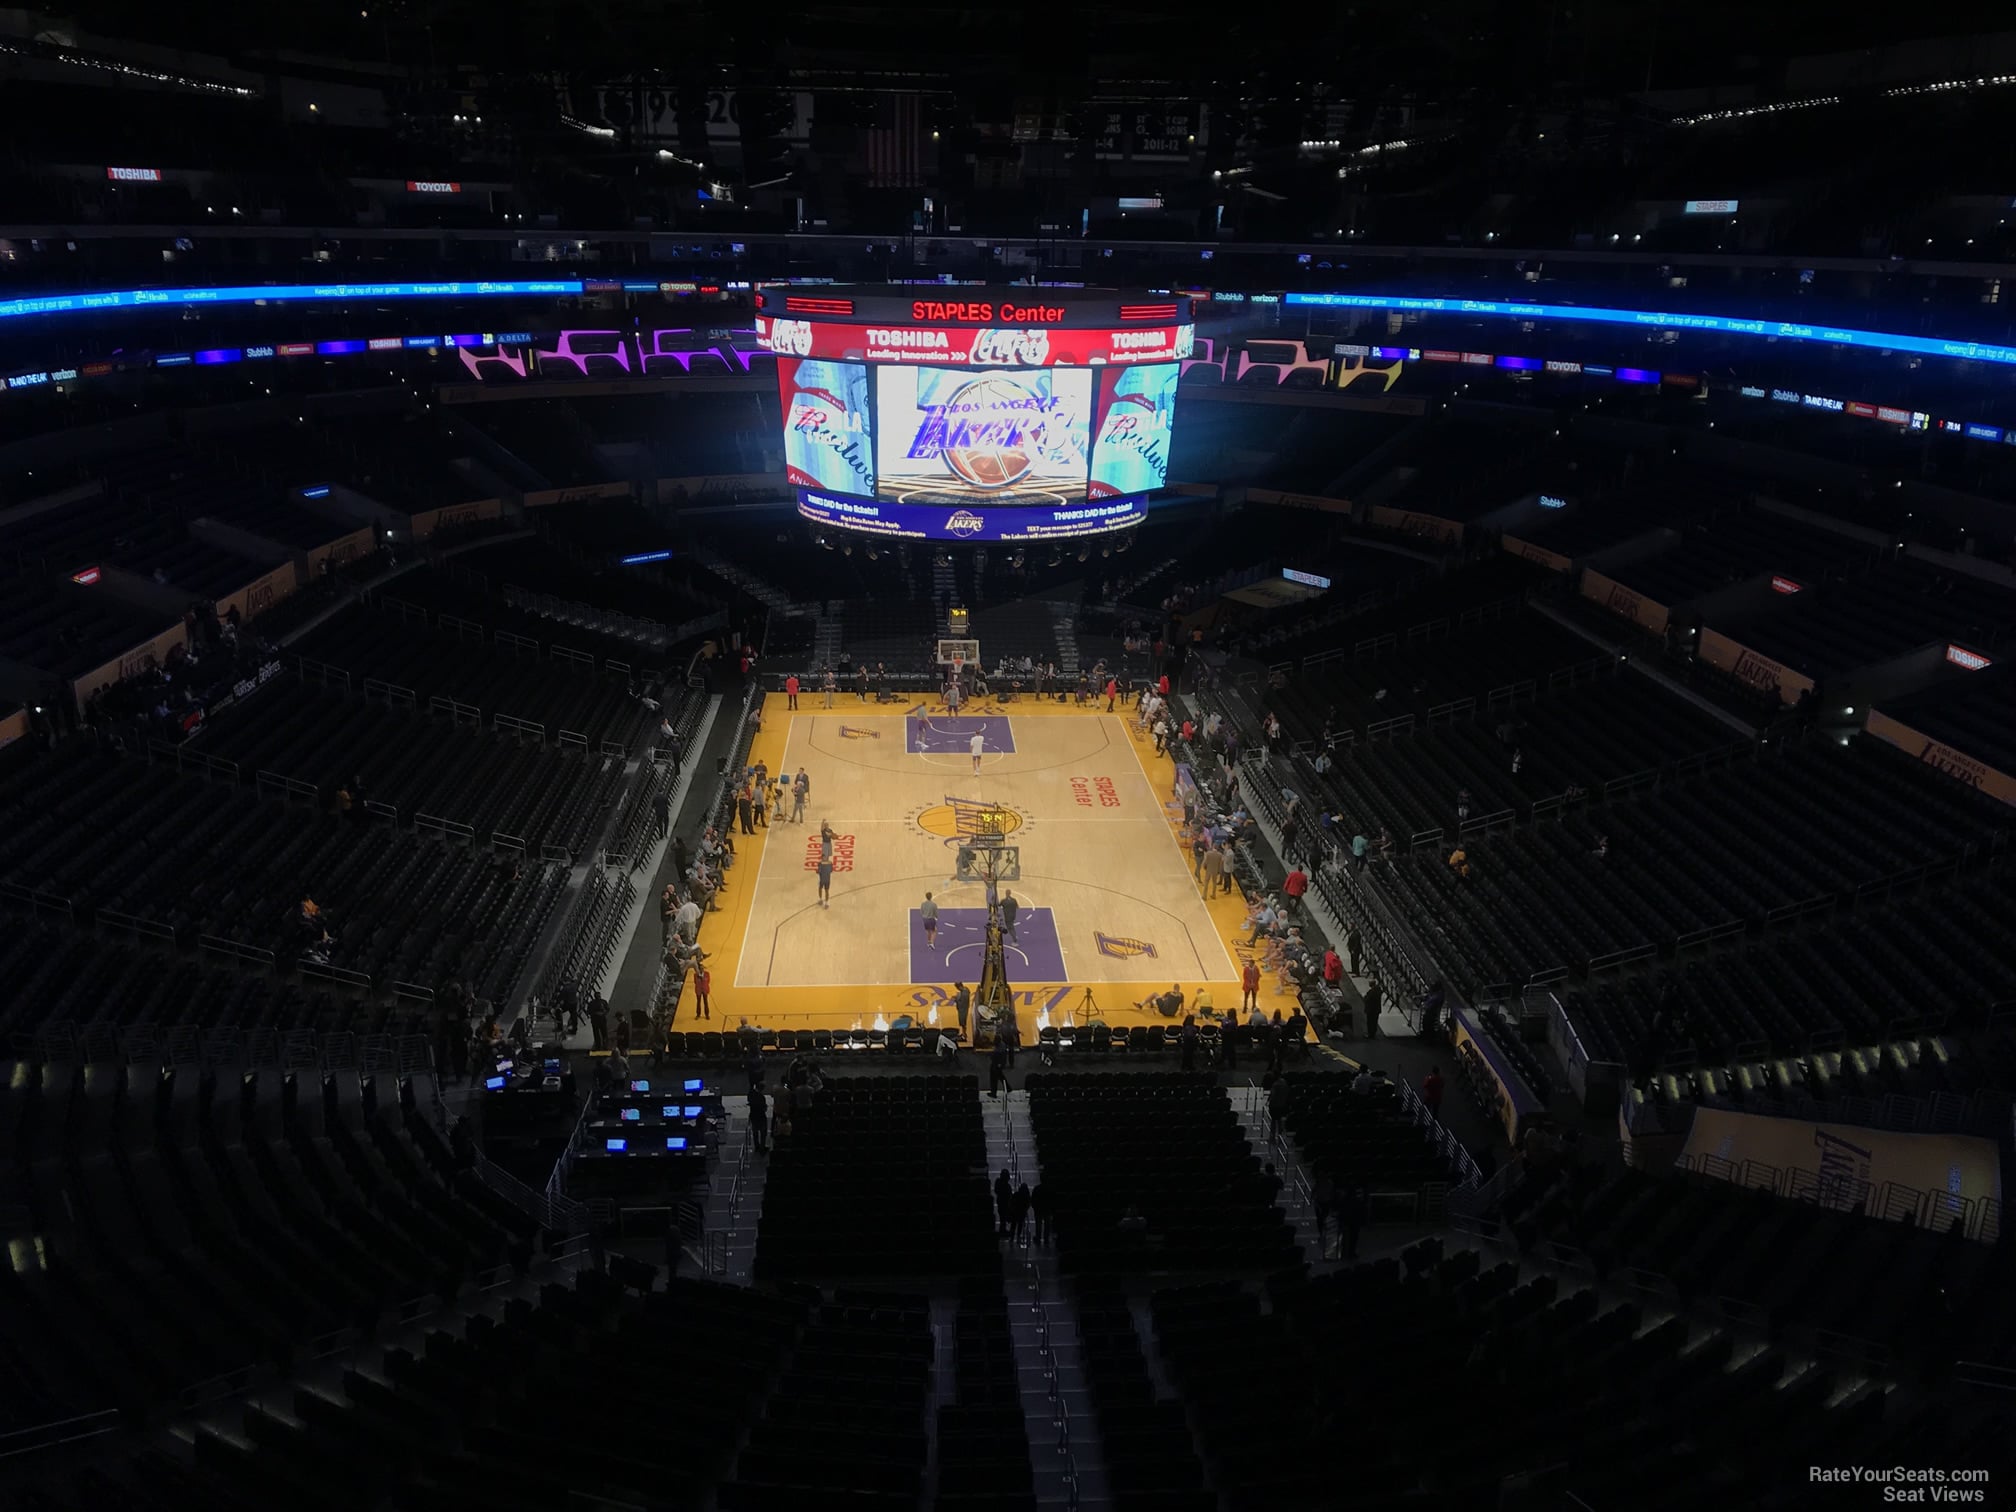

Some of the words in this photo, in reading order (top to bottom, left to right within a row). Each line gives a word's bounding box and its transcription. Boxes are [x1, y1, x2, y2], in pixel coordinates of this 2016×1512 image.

[112, 168, 157, 180] TOSHIBA
[415, 182, 452, 192] TOYOTA
[1696, 201, 1729, 212] STAPLES
[1215, 292, 1244, 302] StubHub
[1251, 294, 1278, 303] verizon
[912, 301, 992, 321] STAPLES
[1000, 303, 1065, 322] Center
[369, 339, 402, 349] TOSHIBA
[506, 334, 531, 342] DELTA
[867, 330, 949, 348] TOSHIBA
[1112, 331, 1166, 348] TOSHIBA
[247, 348, 273, 358] StubHub
[867, 349, 900, 360] Leading
[902, 350, 949, 361] Innovation
[1110, 352, 1136, 361] Leading
[1335, 345, 1369, 356] STAPLES
[1547, 361, 1581, 372] TOYOTA
[51, 368, 77, 381] verizon
[1742, 386, 1765, 398] verizon
[1773, 388, 1800, 402] StubHub
[1878, 406, 1909, 421] TOSHIBA
[1054, 511, 1083, 521] THANKS
[1084, 508, 1098, 517] DAD
[944, 516, 984, 532] LAKERS
[1291, 571, 1322, 587] STAPLES
[1920, 741, 1984, 788] LAKERS
[1937, 747, 1952, 758] LOS
[1953, 754, 1986, 776] ANGELES
[1069, 776, 1094, 808] Center
[1093, 776, 1120, 808] STAPLES
[832, 834, 855, 873] STAPLES
